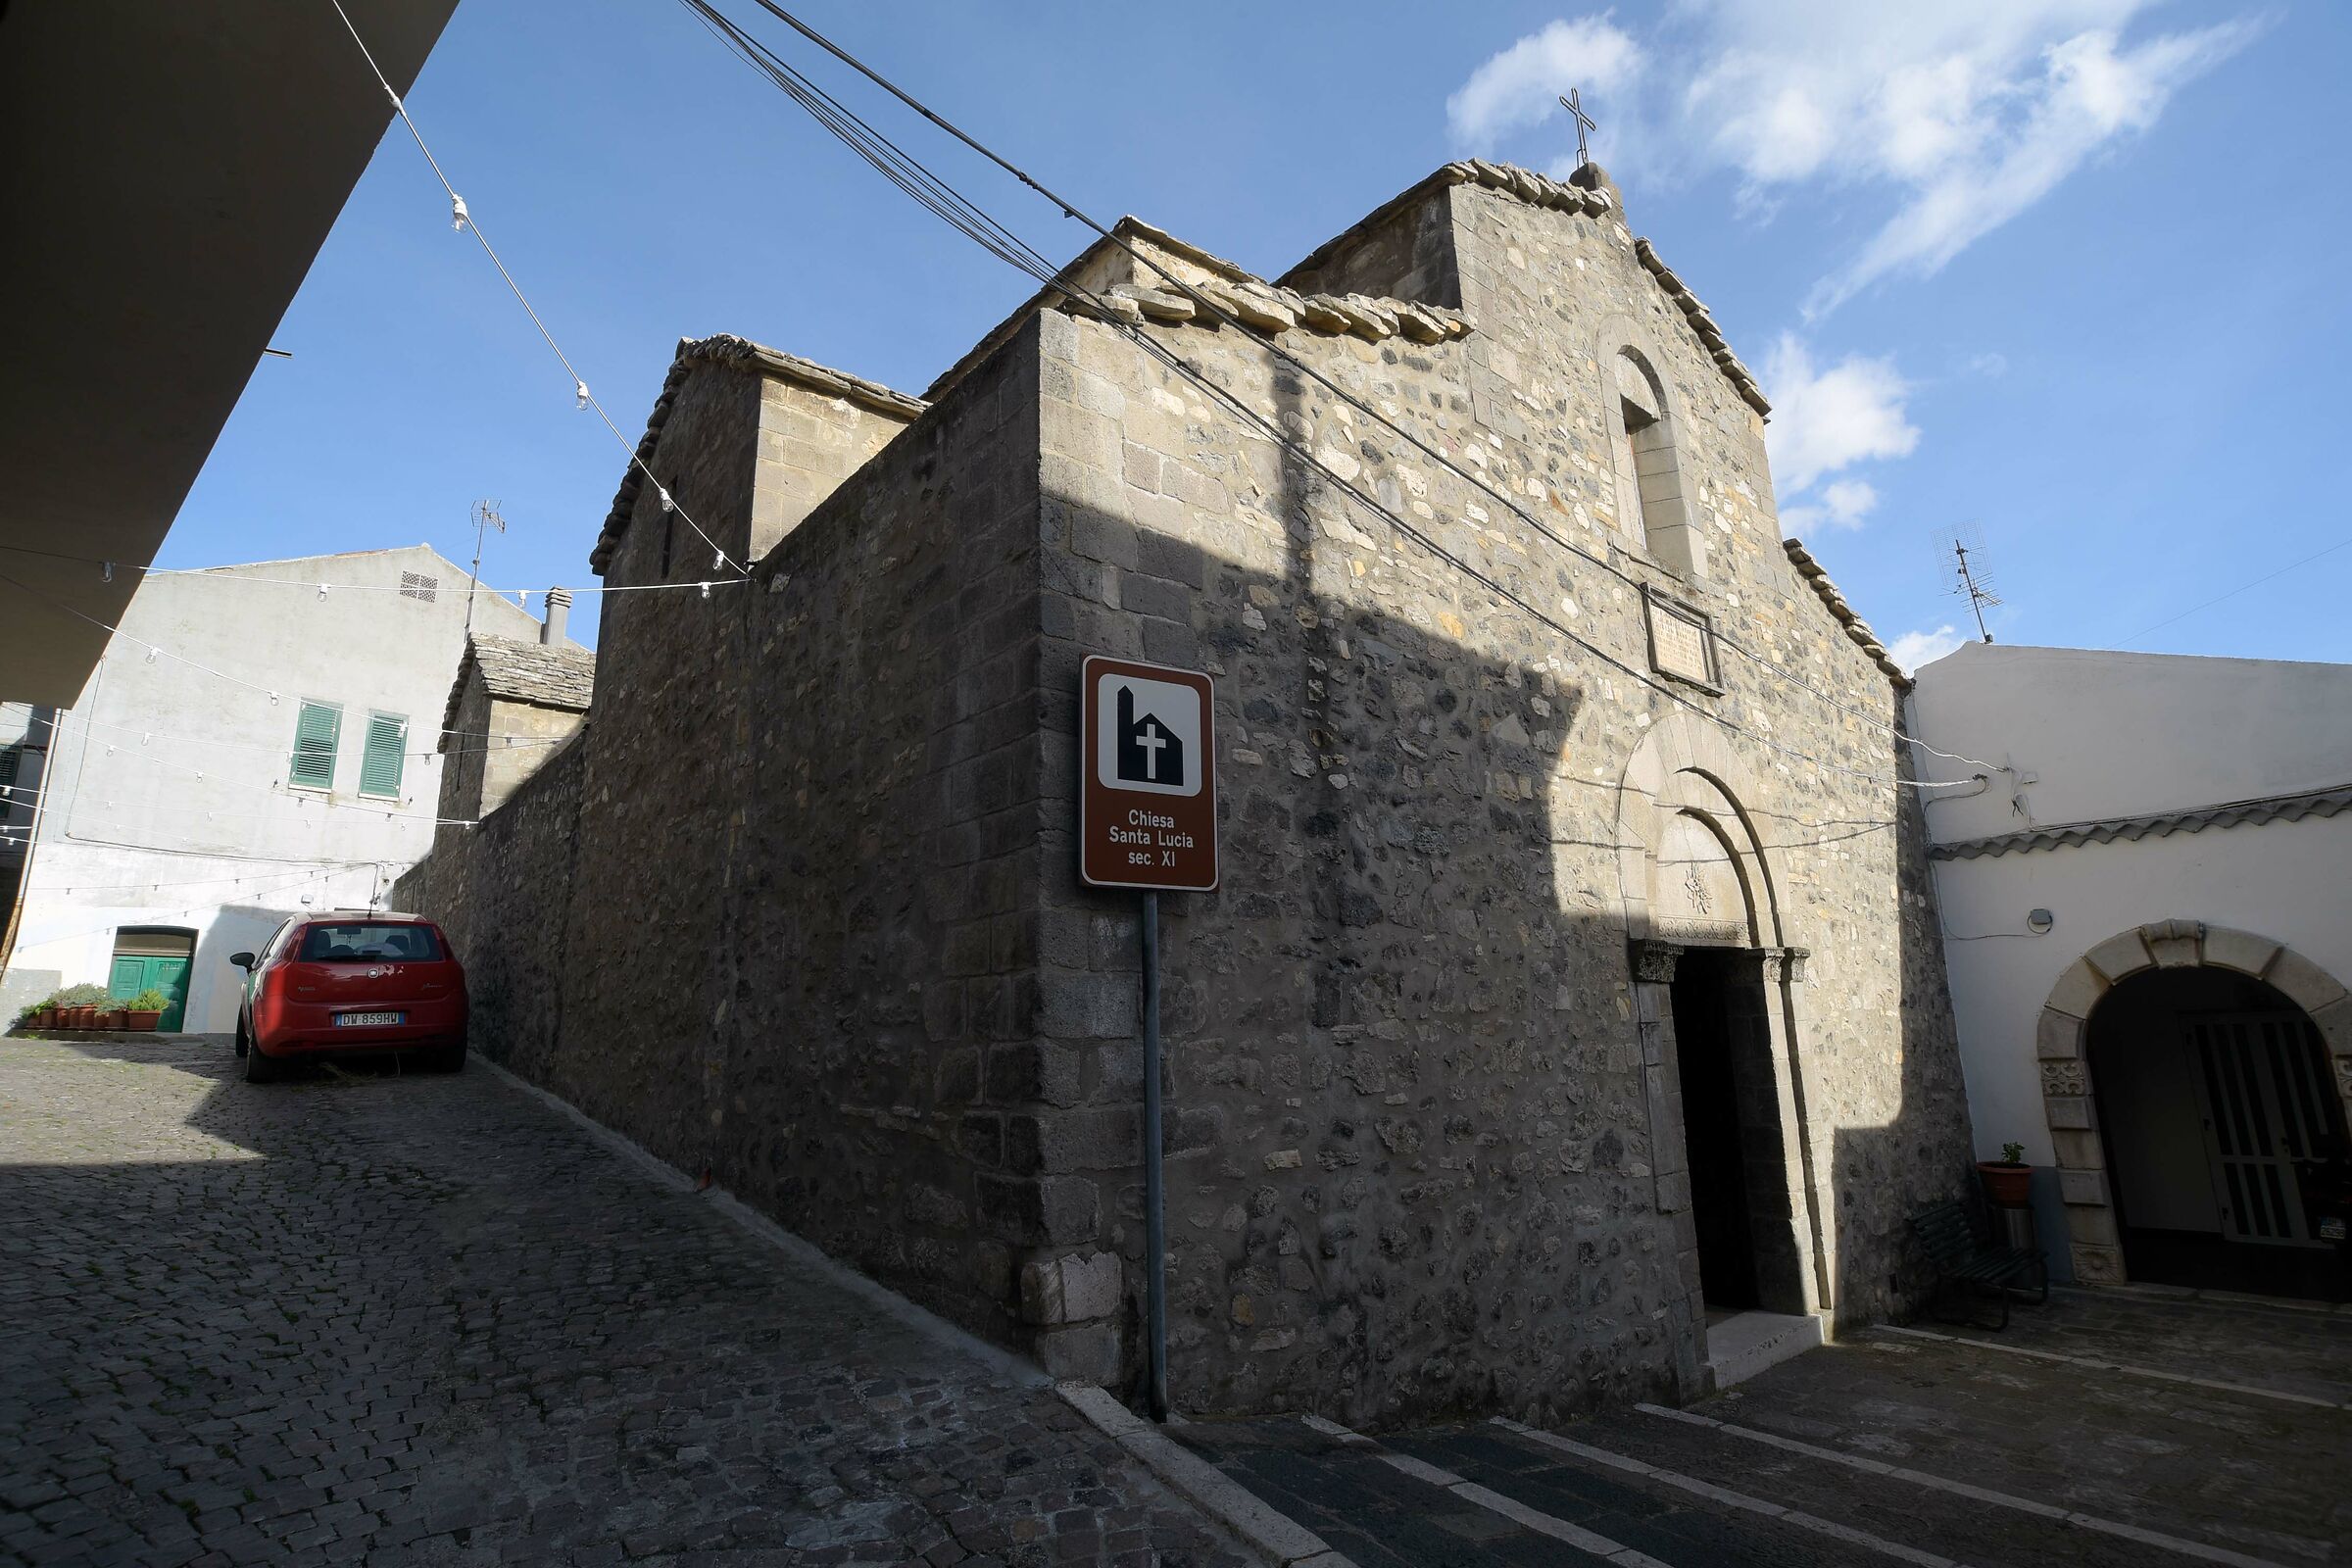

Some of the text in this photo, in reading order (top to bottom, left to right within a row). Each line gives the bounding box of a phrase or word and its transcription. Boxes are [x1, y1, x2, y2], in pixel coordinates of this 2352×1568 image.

[1129, 808, 1175, 828] Chiesa
[1109, 825, 1194, 848] Santa Lucia
[1128, 851, 1175, 867] sec. XI
[343, 1014, 358, 1025] DW
